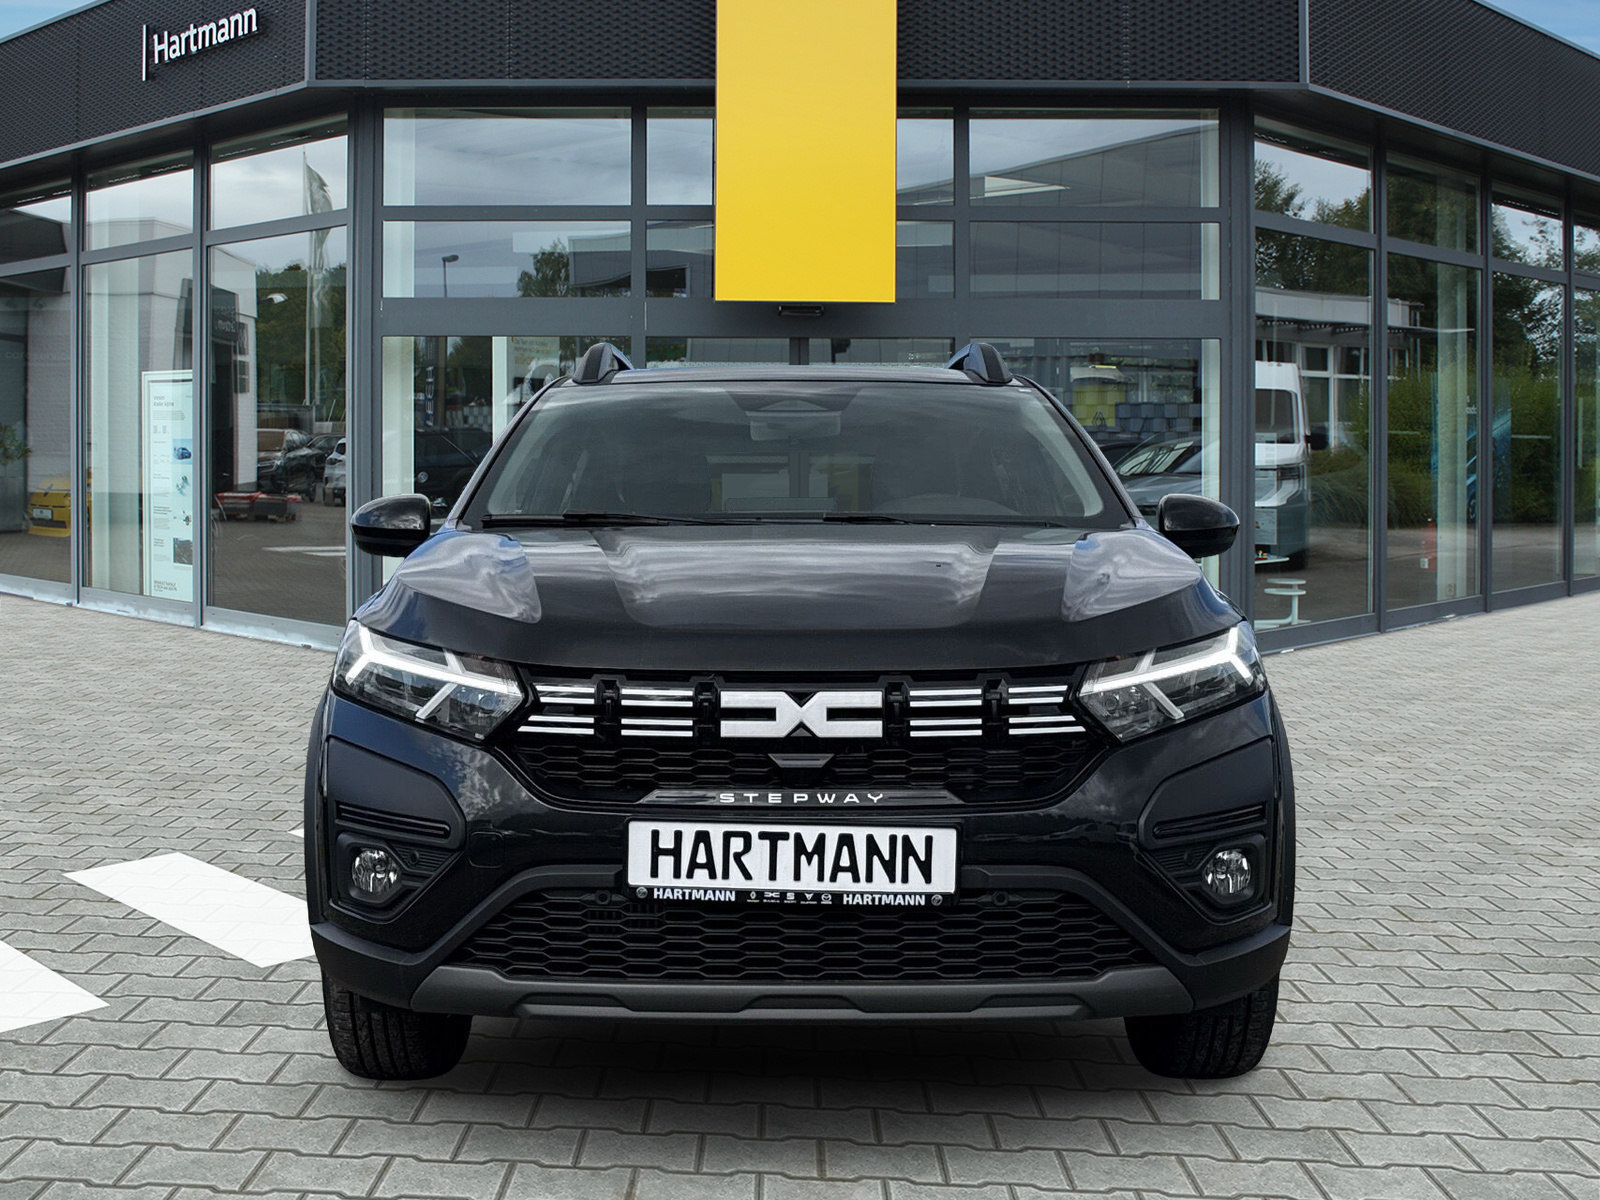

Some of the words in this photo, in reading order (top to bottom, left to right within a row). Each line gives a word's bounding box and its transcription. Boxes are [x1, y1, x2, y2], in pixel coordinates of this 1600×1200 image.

[153, 8, 257, 64] Hartmann
[719, 792, 884, 804] STEPWAY
[650, 829, 933, 884] HARTMANN
[653, 887, 736, 902] HARTMANN
[843, 893, 925, 906] HARTMANN
